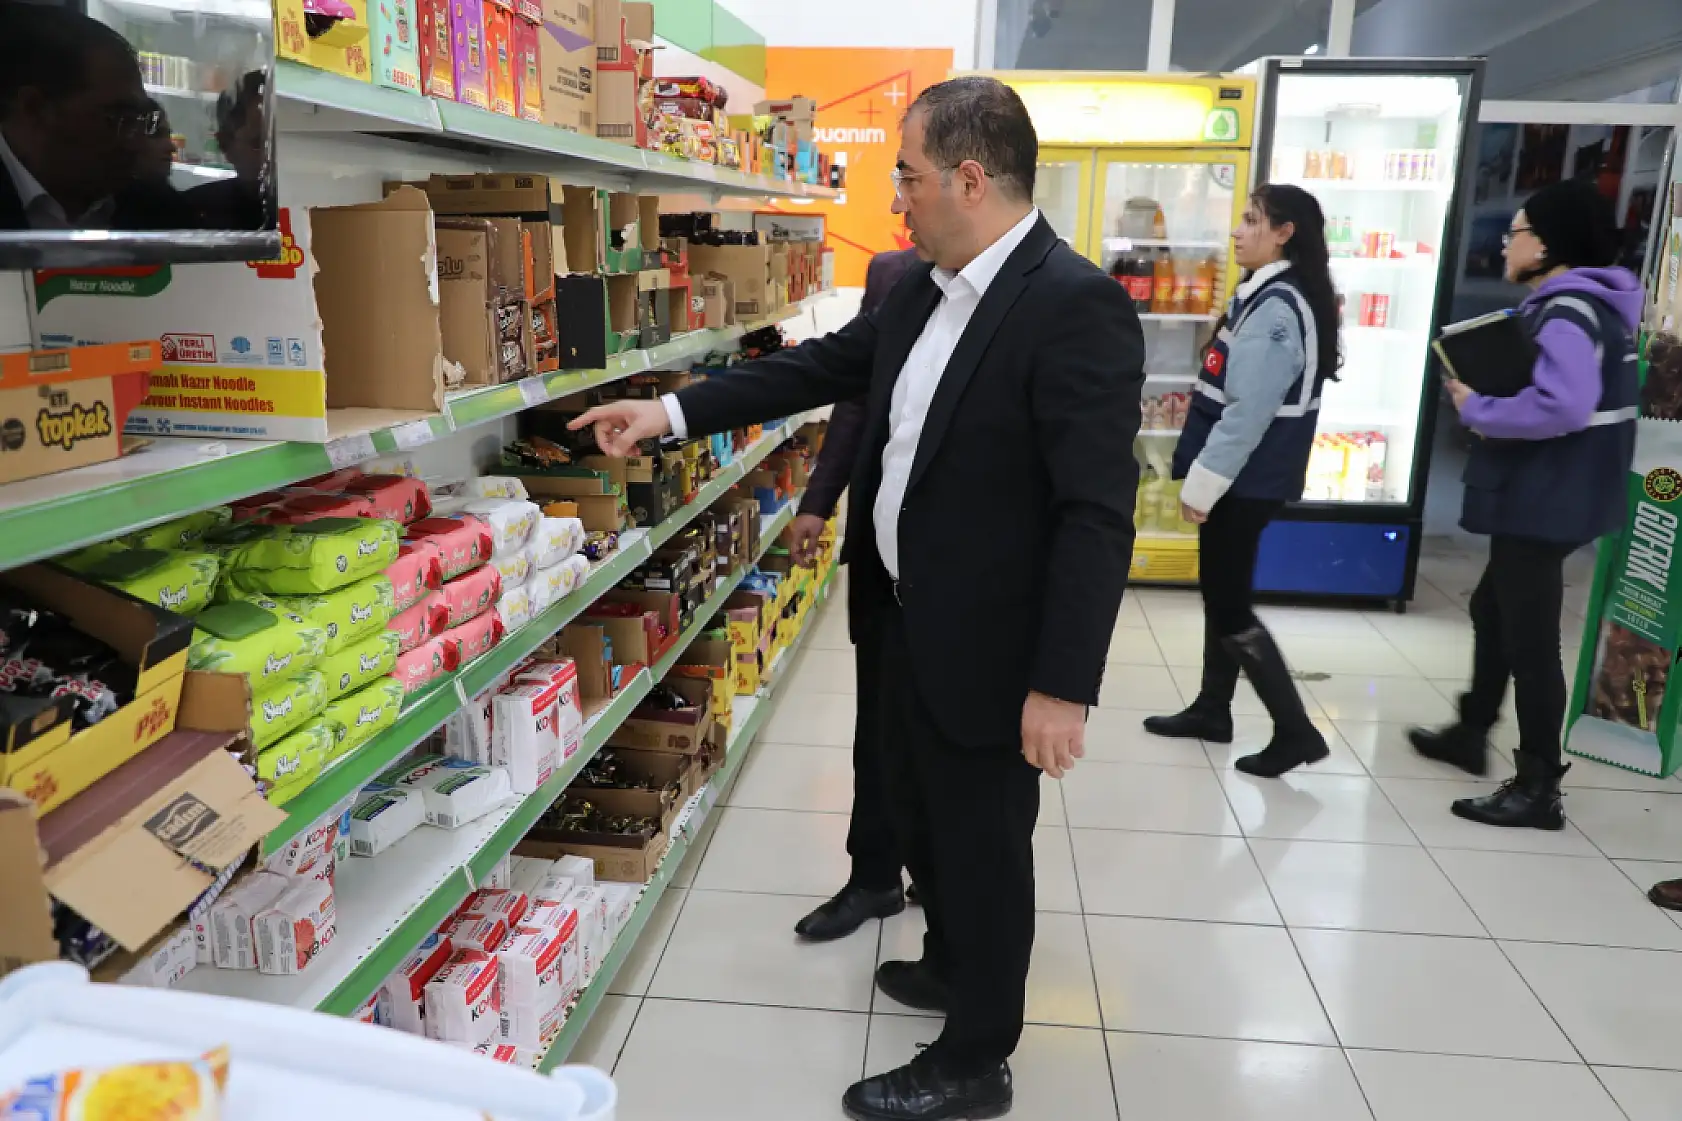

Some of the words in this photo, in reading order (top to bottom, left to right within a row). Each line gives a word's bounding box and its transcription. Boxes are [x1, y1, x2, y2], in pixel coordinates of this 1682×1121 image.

[100, 280, 136, 292] Noodle
[213, 375, 256, 391] Noodle
[179, 394, 222, 410] Instant
[224, 397, 275, 413] Noodles
